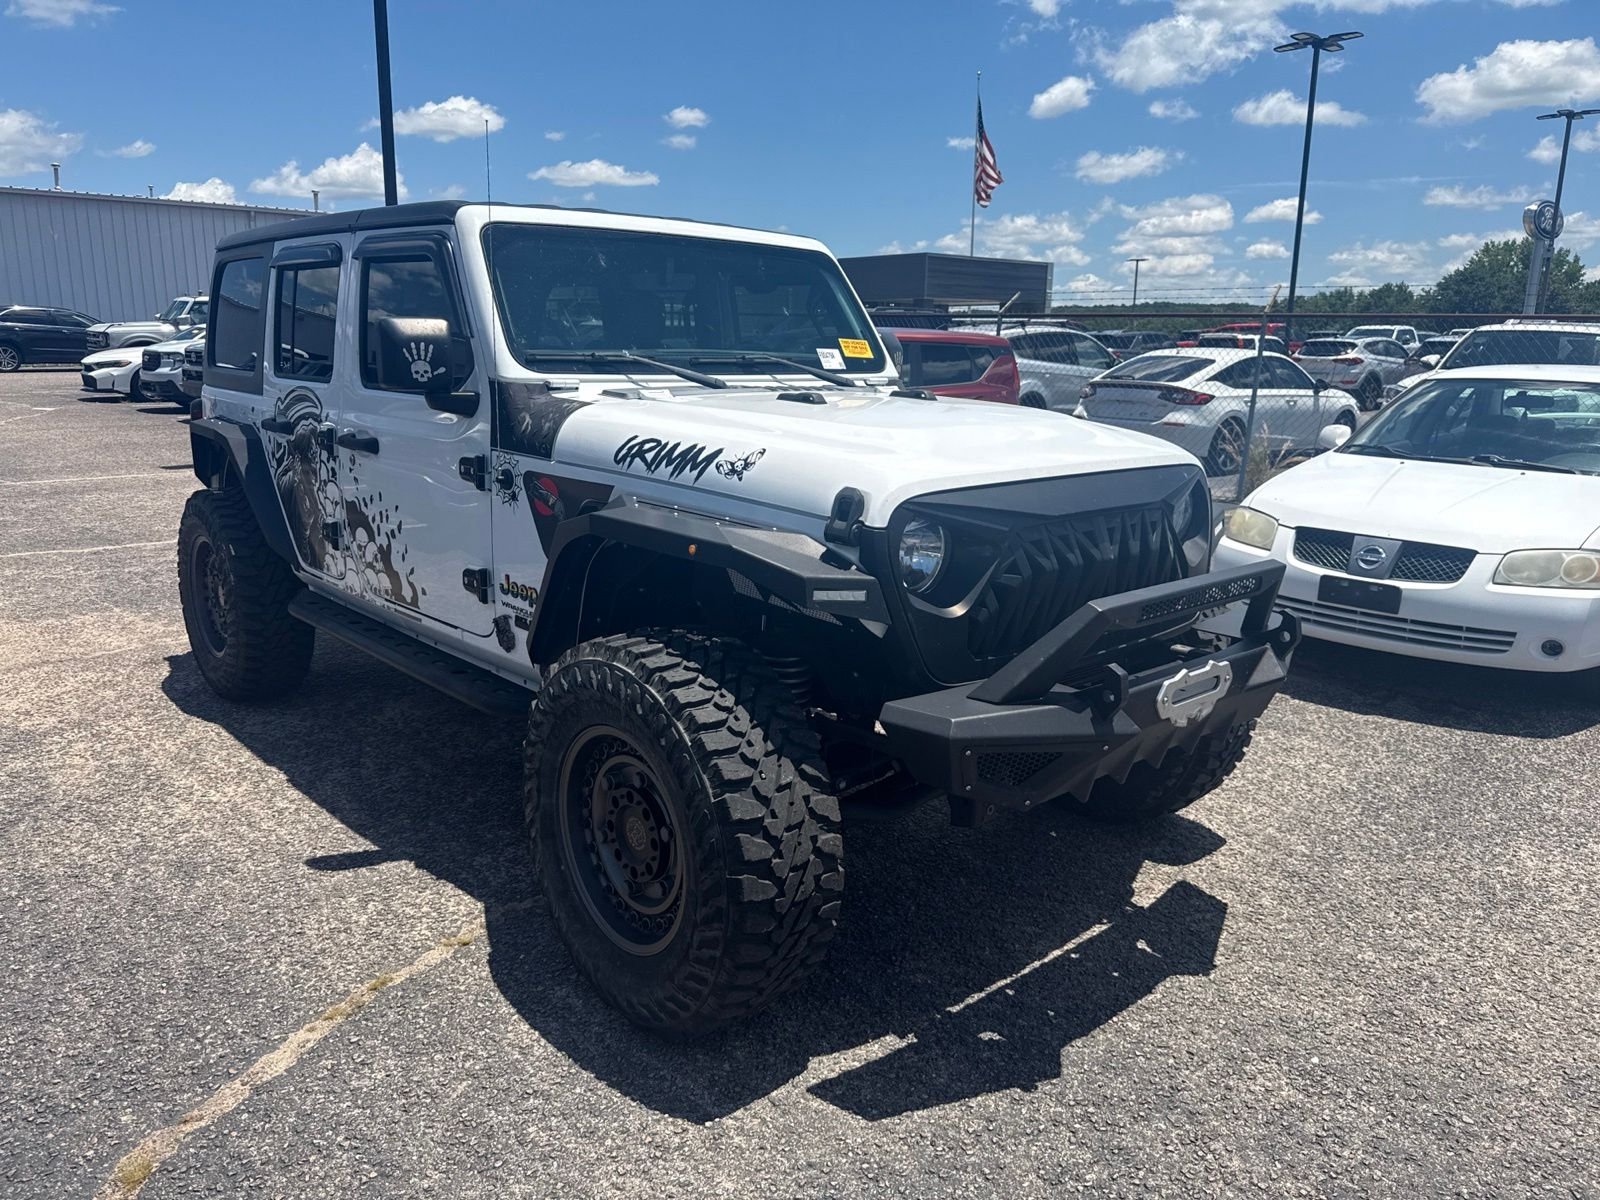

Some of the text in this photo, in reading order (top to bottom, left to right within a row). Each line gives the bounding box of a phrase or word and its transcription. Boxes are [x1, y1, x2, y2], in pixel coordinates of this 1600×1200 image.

[613, 435, 725, 486] GRIMM
[499, 574, 538, 608] Jeep
[501, 599, 535, 617] WRANGLE
